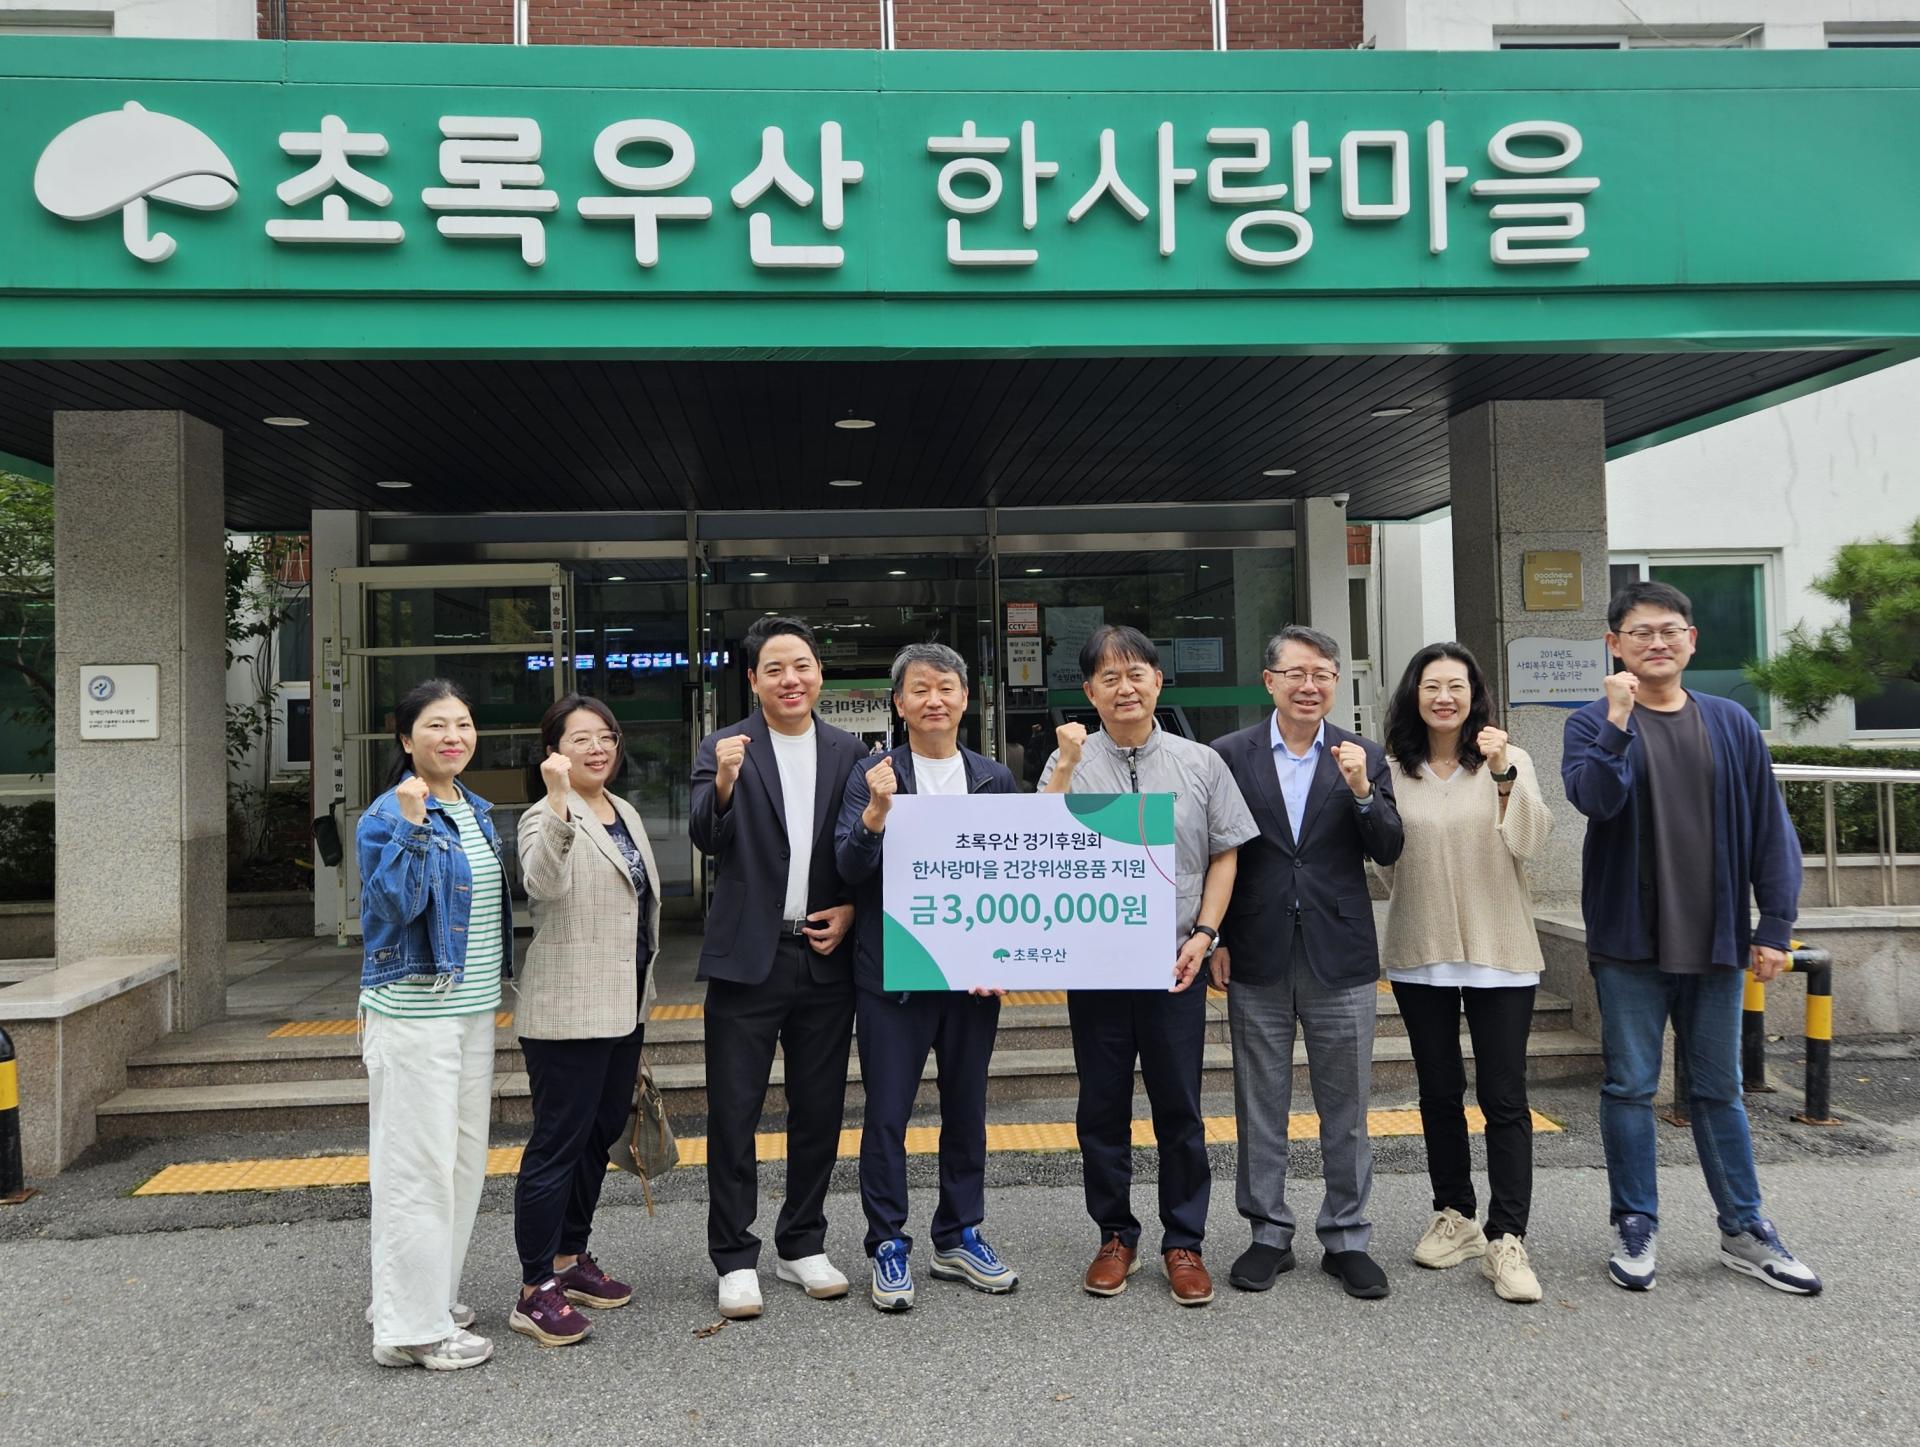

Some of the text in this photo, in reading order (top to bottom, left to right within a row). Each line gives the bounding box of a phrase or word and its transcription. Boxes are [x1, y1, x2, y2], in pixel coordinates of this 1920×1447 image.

[265, 114, 1601, 269] 초록우산 한사랑마을
[1540, 650, 1573, 659] 2014년도
[955, 832, 1102, 851] 초록우산 경기후원회
[912, 859, 1145, 880] 한사랑마을 건강위생용품 지원
[909, 893, 1148, 931] 금3,000,000원
[1013, 948, 1067, 963] 초록우산
